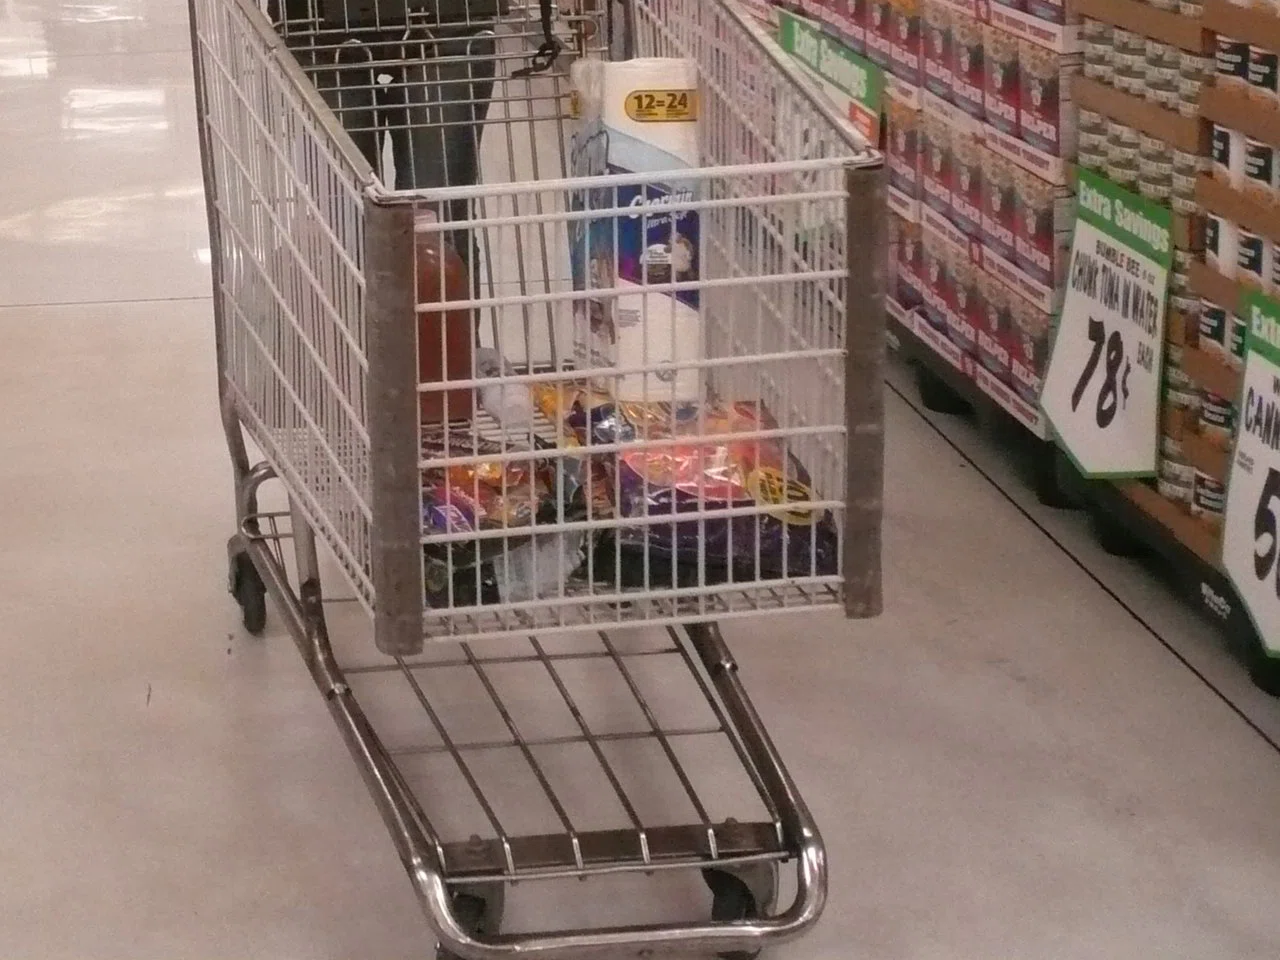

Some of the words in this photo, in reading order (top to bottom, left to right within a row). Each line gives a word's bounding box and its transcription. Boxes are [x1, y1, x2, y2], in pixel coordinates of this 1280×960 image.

[1079, 180, 1111, 221] Extra
[1115, 199, 1169, 252] Savings
[1096, 239, 1124, 269] BUMBLE
[1126, 256, 1140, 278] BEE
[1252, 304, 1280, 351] Ext
